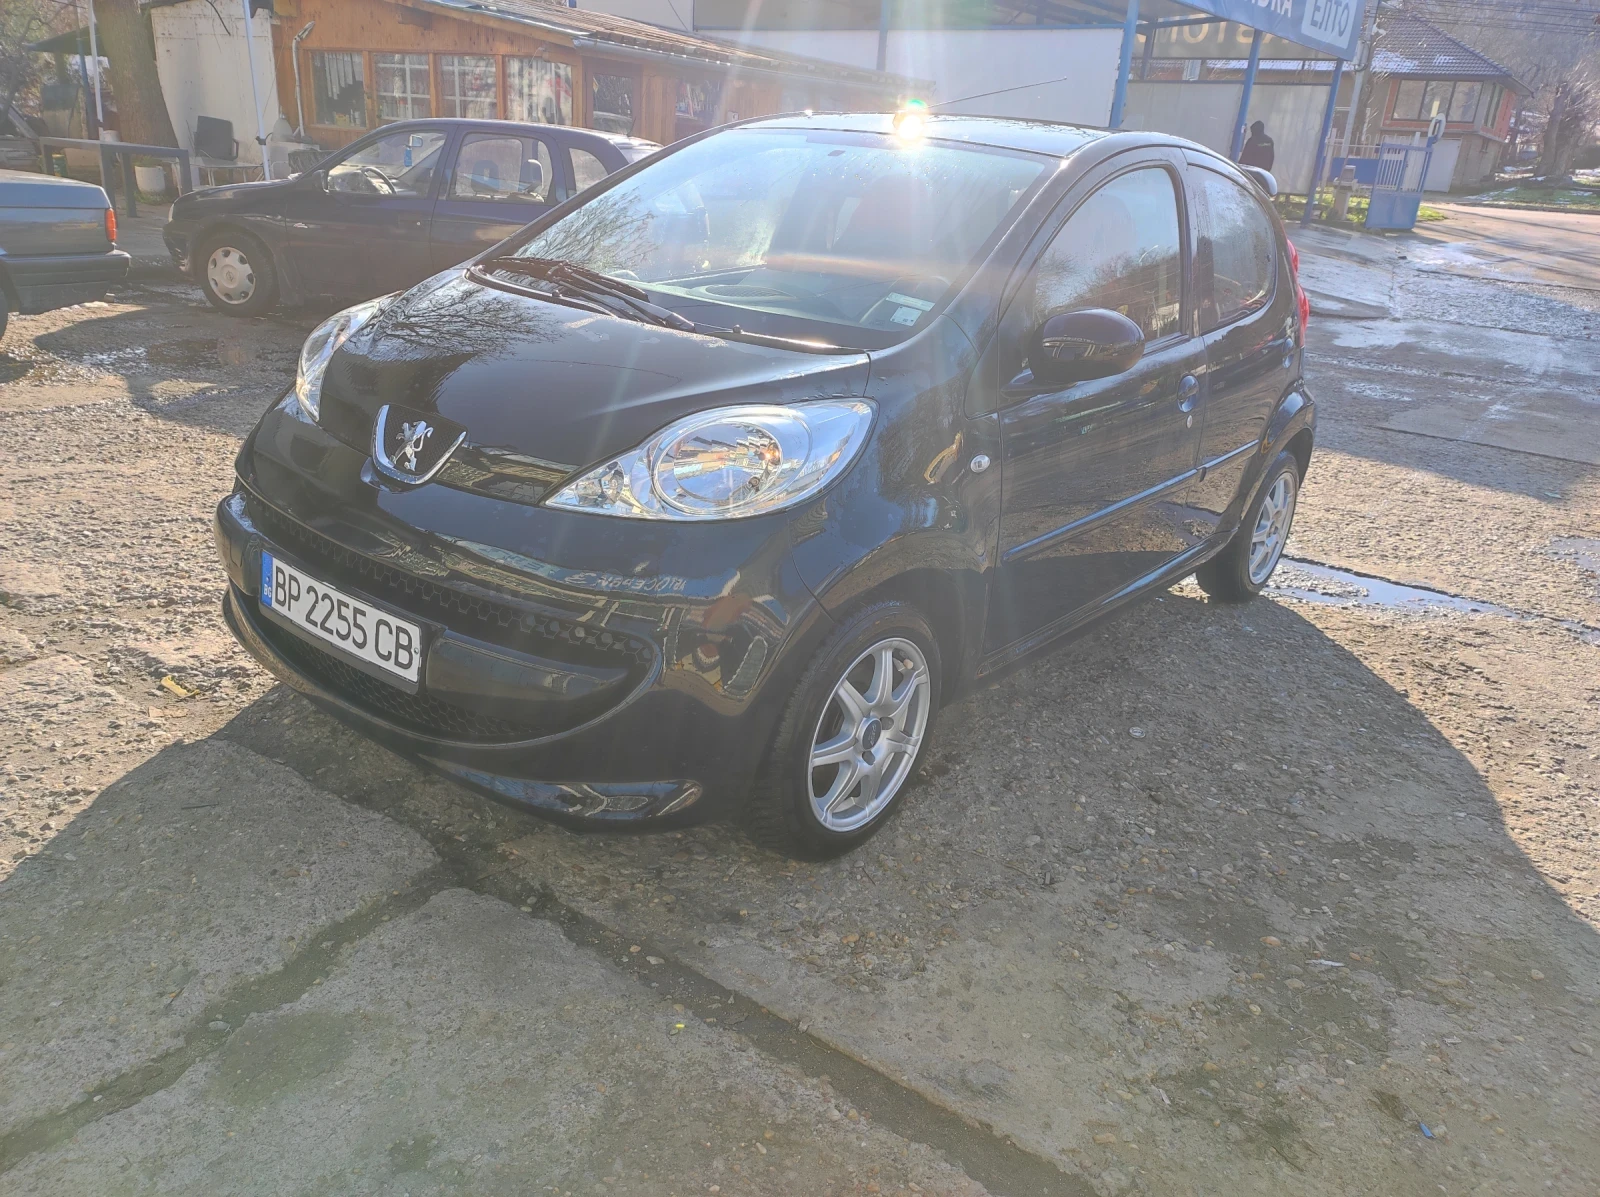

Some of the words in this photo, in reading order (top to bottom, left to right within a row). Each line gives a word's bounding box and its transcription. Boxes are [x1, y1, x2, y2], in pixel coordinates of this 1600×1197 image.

[275, 565, 301, 613] BP
[305, 585, 368, 650] 2255
[374, 618, 414, 671] CB
